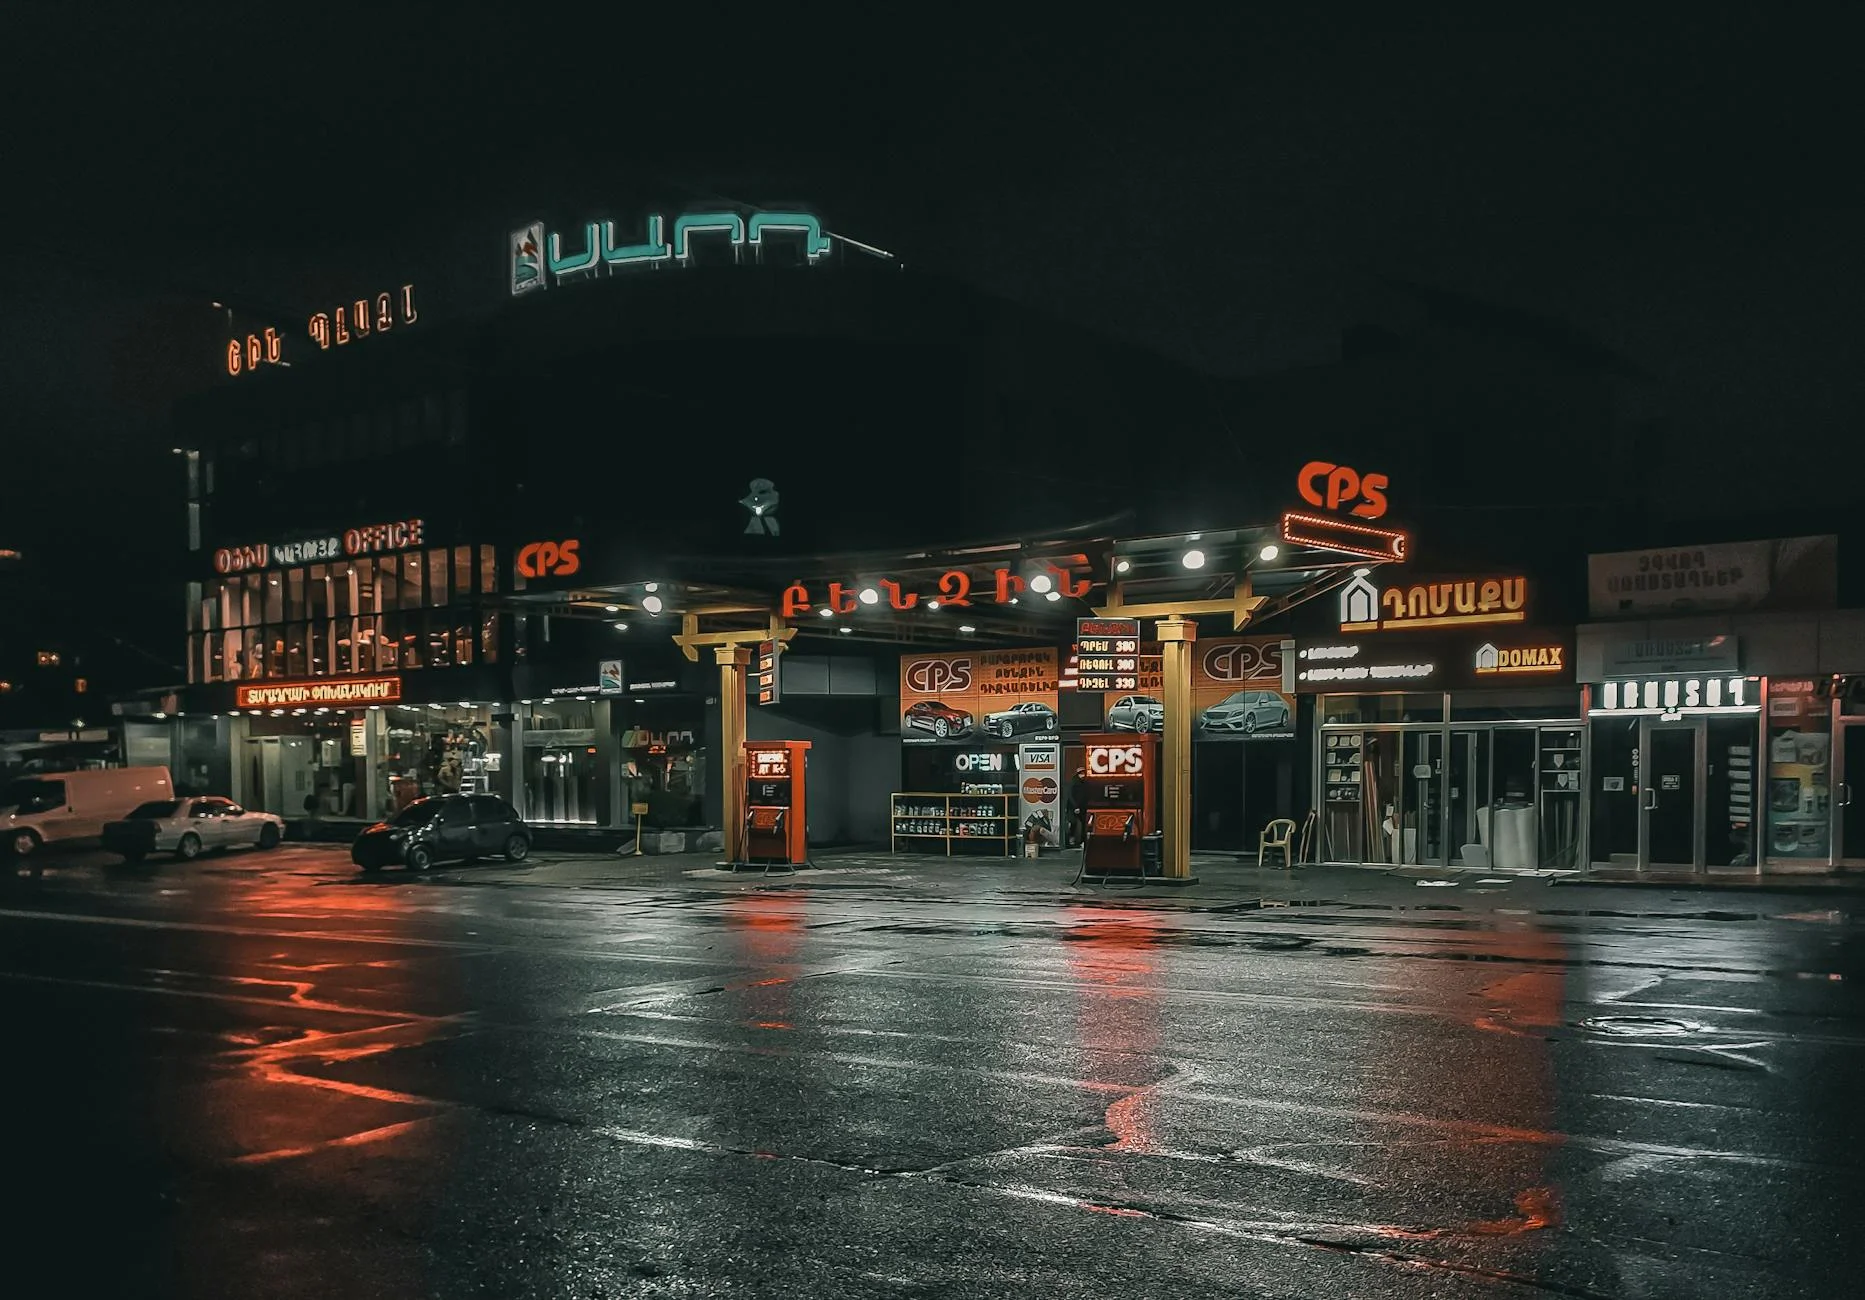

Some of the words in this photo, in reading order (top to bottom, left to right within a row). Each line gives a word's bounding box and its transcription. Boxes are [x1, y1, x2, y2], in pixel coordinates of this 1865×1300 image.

[307, 284, 418, 350] ՊԼԱԶԱ
[1297, 460, 1389, 519] CPS
[344, 519, 424, 555] OFFICE
[516, 539, 580, 578] CPS
[1382, 577, 1526, 620] ԴՈՄԱՔՍ
[906, 658, 973, 693] CPS
[1203, 643, 1283, 681] CPS
[1498, 648, 1562, 667] DOMAX
[955, 752, 1002, 772] OPEN
[1029, 753, 1051, 764] VISA
[1090, 747, 1143, 774] CPS
